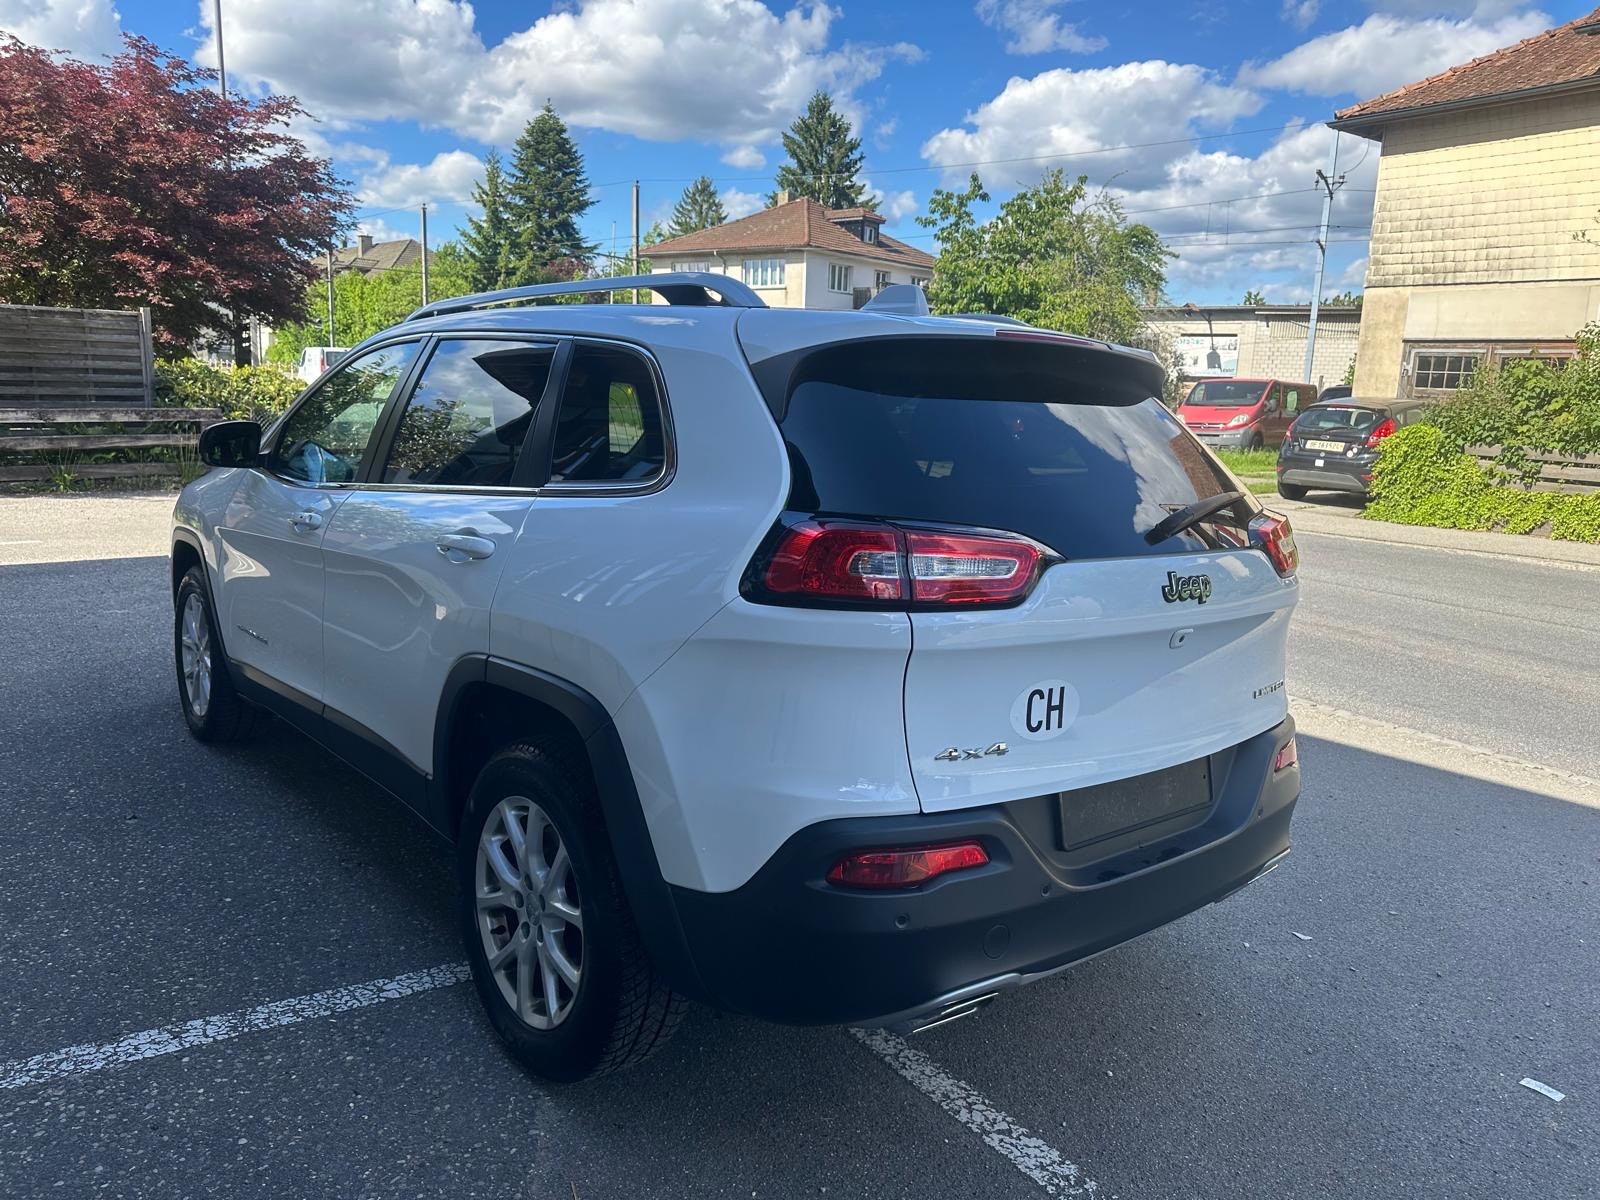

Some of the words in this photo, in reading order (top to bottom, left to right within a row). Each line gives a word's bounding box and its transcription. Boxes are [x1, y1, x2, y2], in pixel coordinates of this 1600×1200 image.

[1161, 570, 1212, 605] Jeep
[1026, 686, 1065, 733] CH
[934, 742, 1009, 762] 4x4
